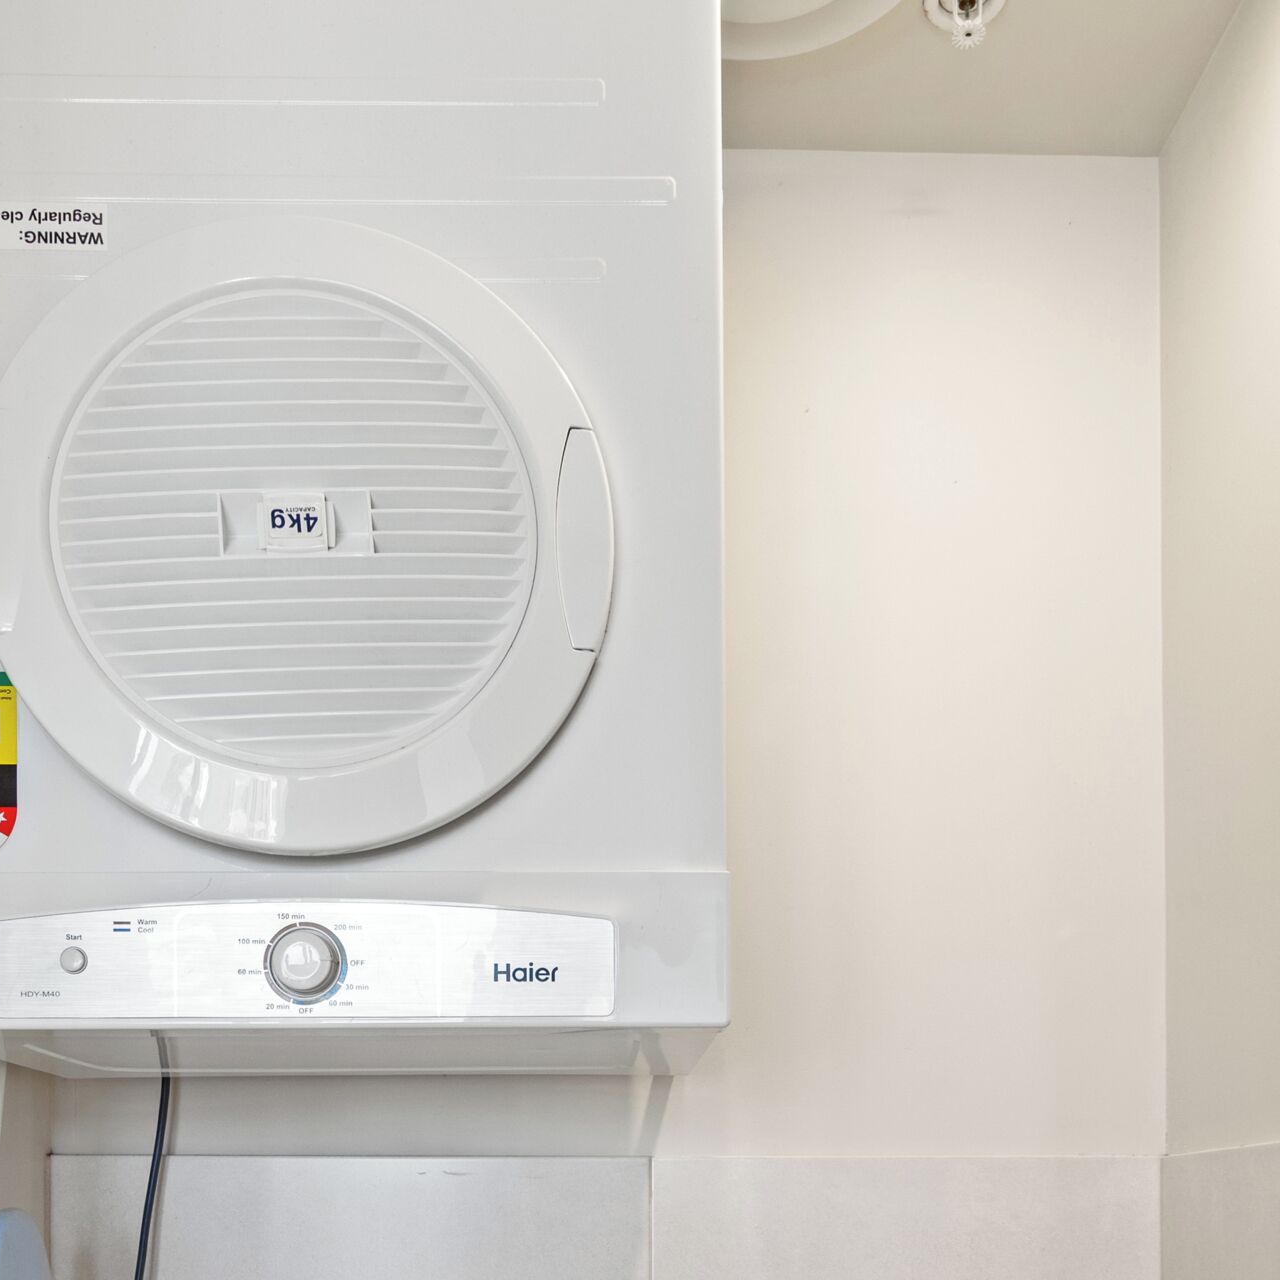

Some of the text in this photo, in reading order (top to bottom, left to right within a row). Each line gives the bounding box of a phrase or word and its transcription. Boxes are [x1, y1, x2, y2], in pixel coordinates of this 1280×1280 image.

[28, 209, 103, 225] Regularly
[19, 231, 103, 245] WARNING:
[271, 509, 318, 533] 4kg
[492, 962, 558, 982] Haier
